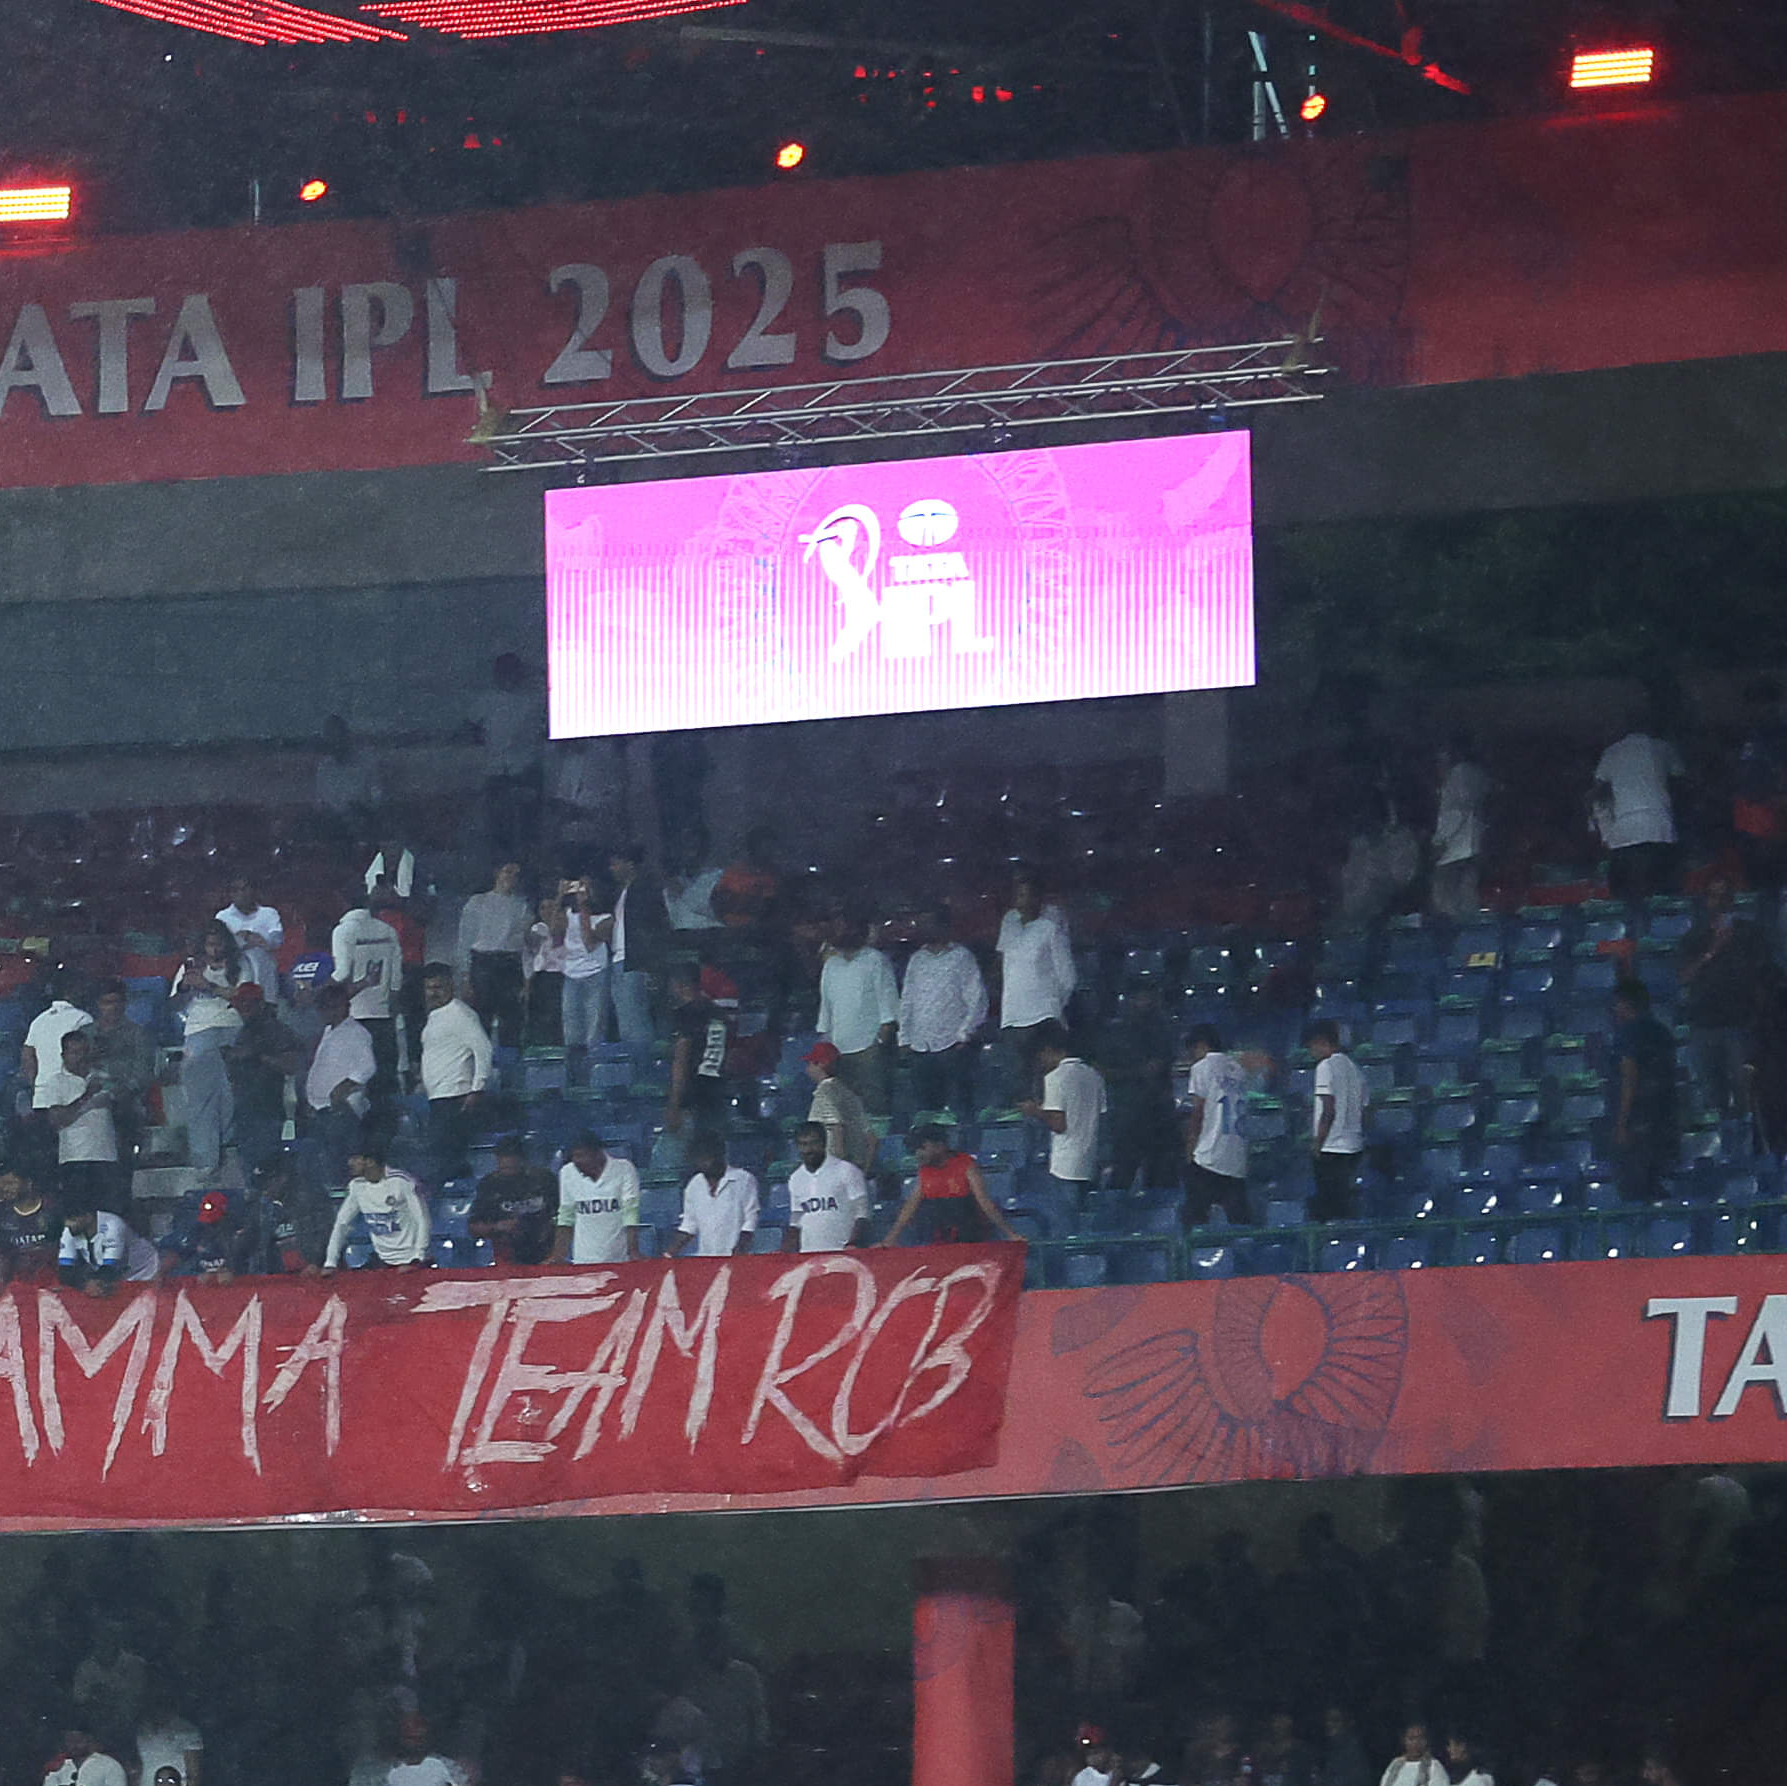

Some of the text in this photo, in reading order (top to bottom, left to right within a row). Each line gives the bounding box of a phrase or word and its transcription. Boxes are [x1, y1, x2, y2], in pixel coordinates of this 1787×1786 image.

[292, 276, 493, 399] IPL
[544, 241, 891, 384] 2025
[413, 1263, 731, 1490] TEAM
[742, 1252, 1004, 1462] RCB
